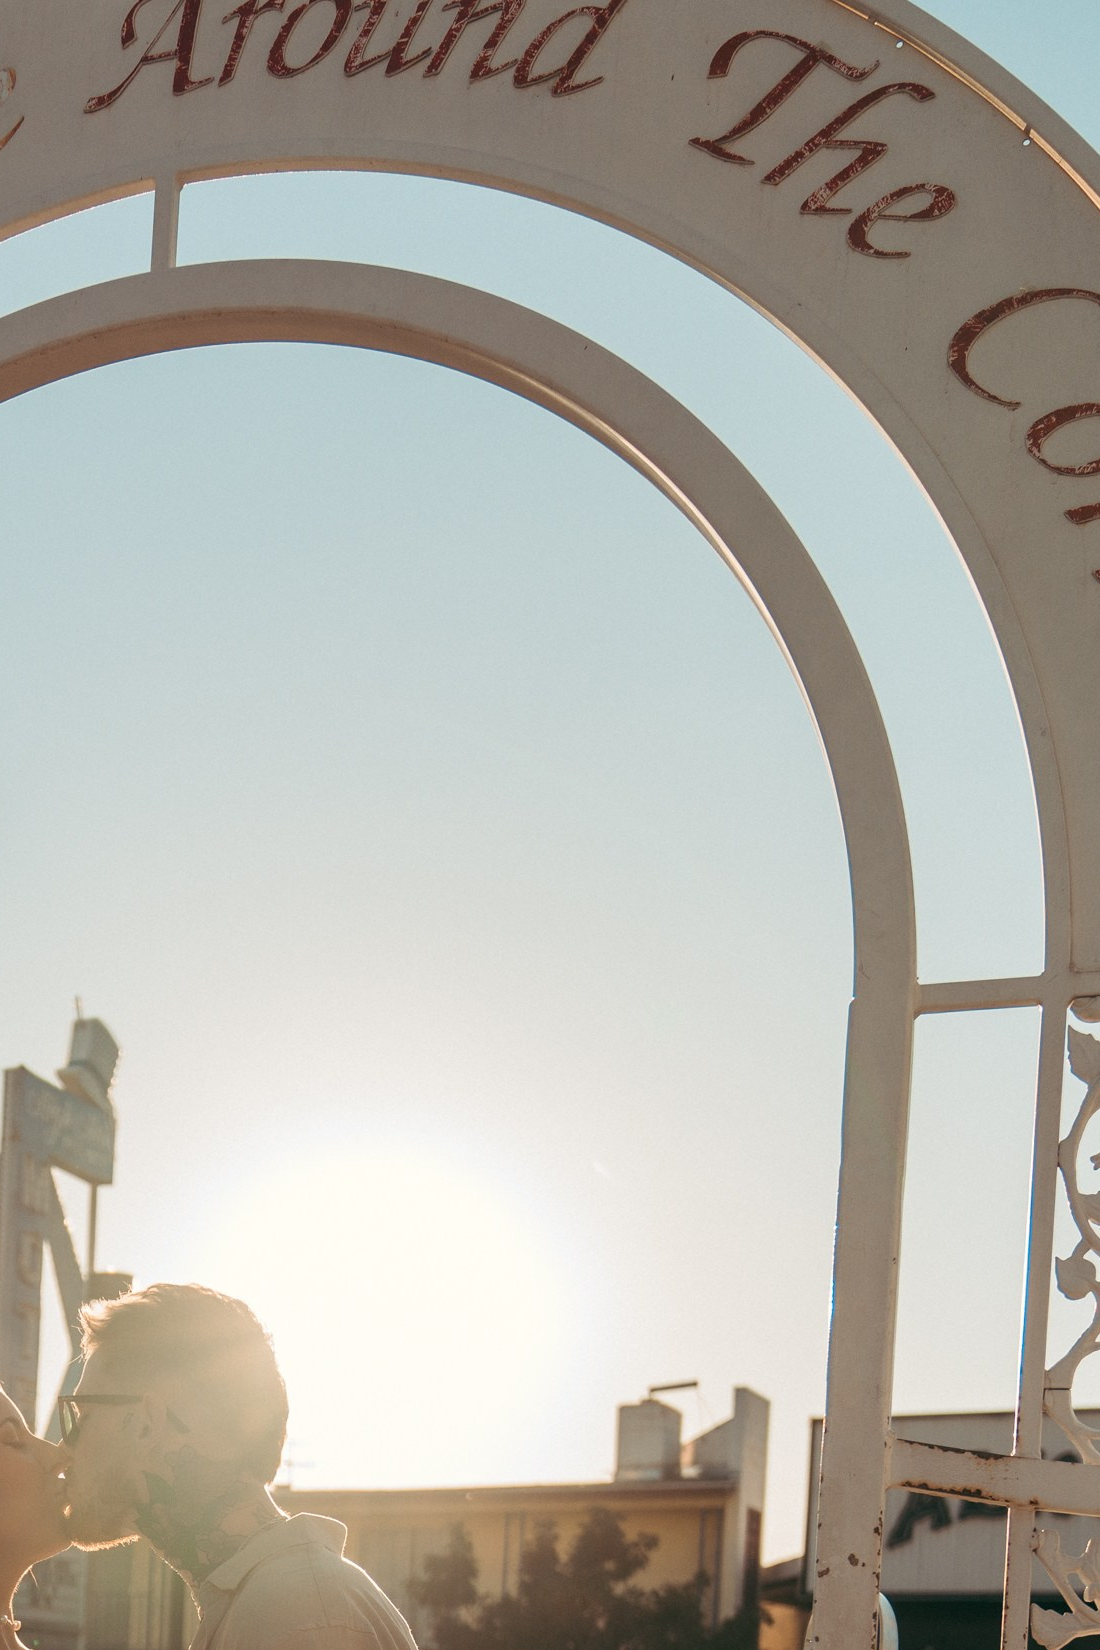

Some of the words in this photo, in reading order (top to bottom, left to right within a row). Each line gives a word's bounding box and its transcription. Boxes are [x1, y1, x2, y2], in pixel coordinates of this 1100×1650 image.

[83, 0, 628, 113] Around
[688, 30, 956, 259] The
[947, 287, 1100, 586] Co
